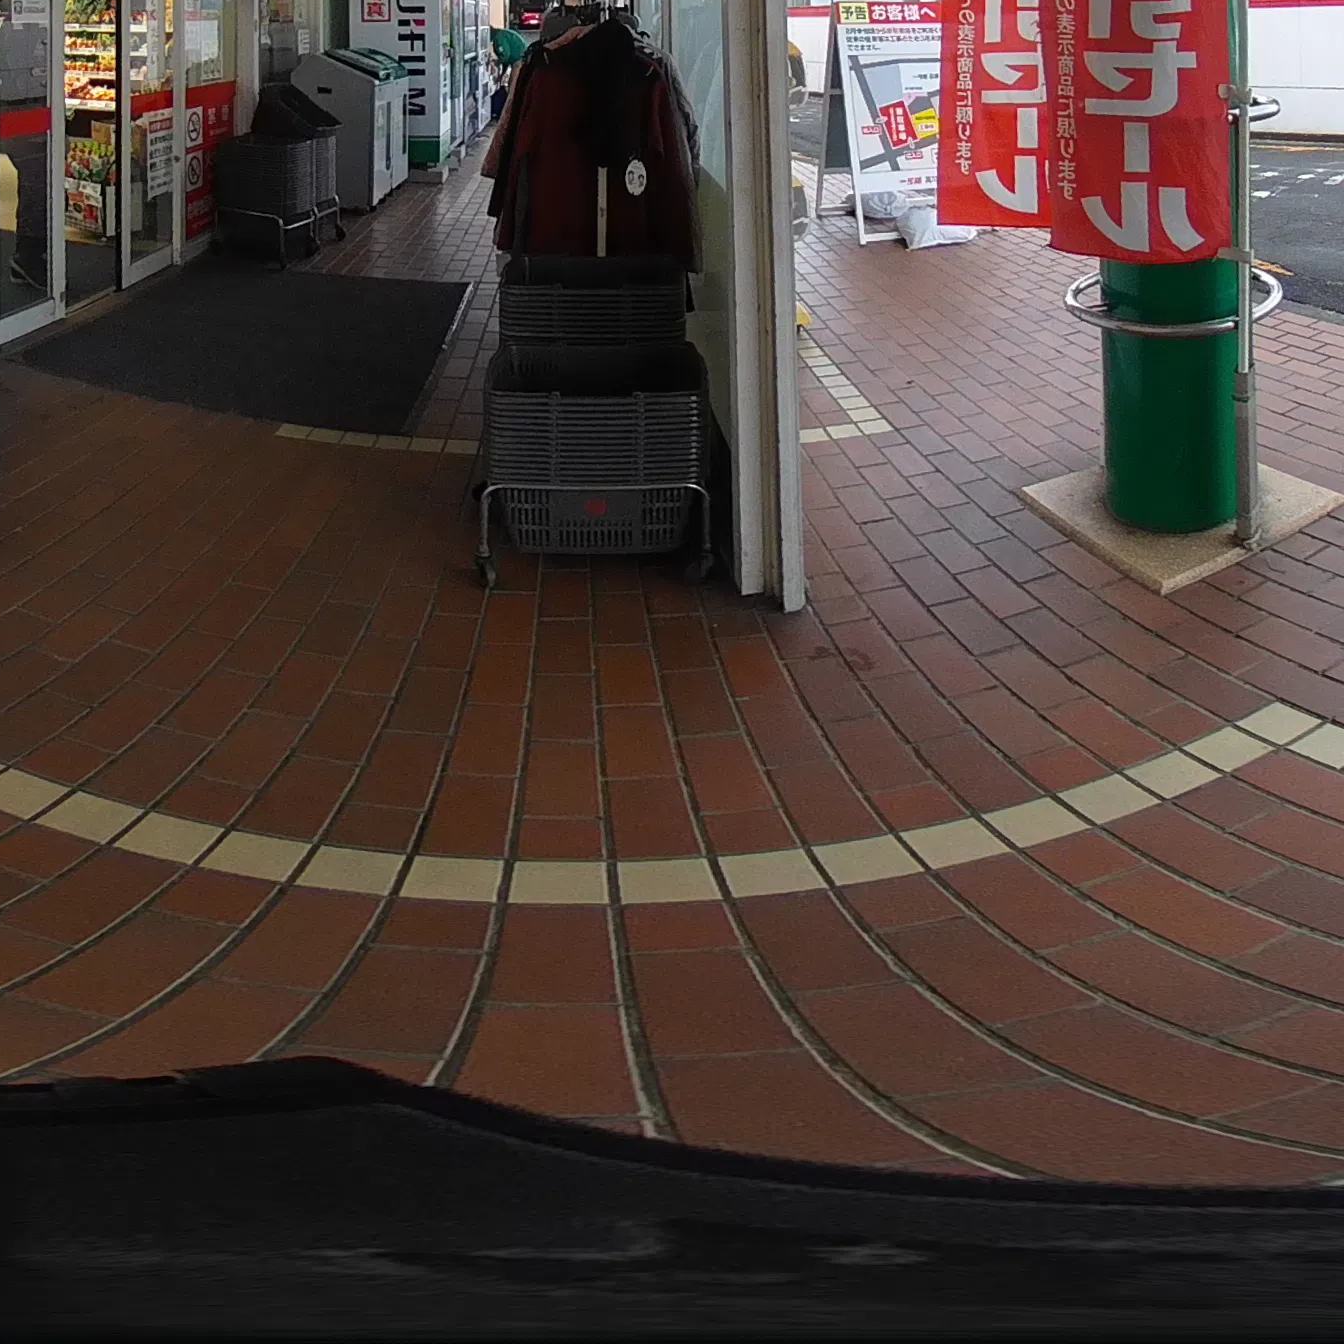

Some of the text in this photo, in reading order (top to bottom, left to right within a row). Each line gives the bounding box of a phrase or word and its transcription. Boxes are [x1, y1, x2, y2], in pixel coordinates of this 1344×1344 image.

[841, 5, 868, 20] 予告
[870, 4, 937, 21] お客様へ
